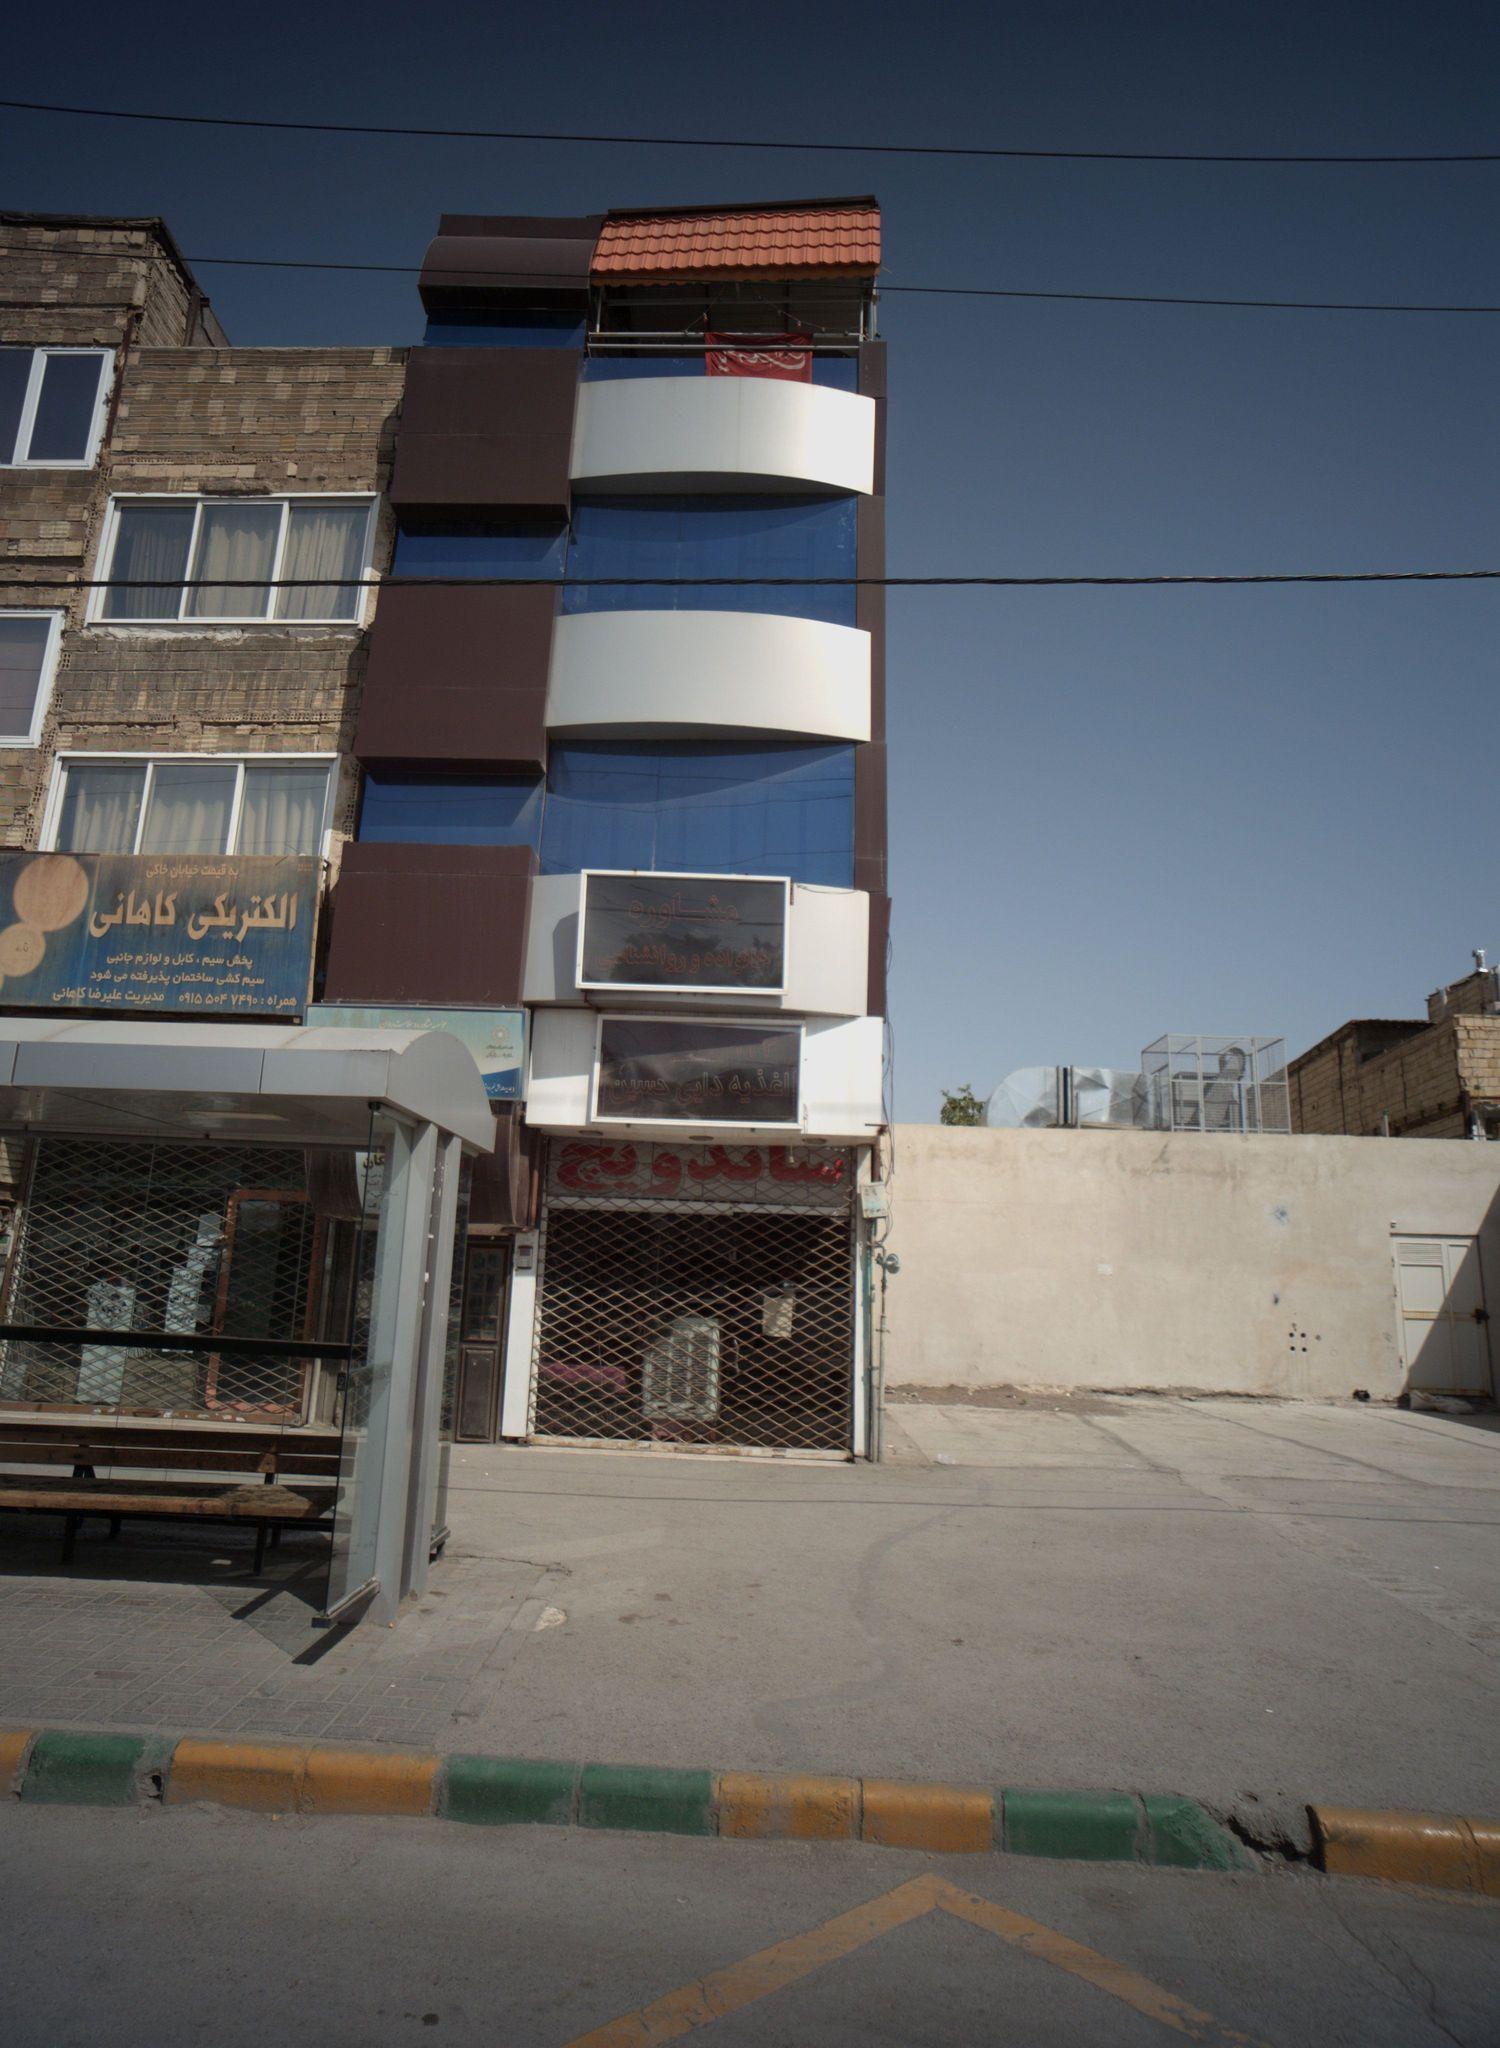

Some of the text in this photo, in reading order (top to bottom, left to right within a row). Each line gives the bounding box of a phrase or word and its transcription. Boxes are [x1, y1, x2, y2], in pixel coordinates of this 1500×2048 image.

[170, 864, 199, 878] خیابان
[200, 863, 226, 877] قیمت
[228, 866, 239, 878] به
[89, 889, 299, 943] الکتریکی کاهانی
[106, 953, 133, 966] جانبی
[135, 953, 162, 966] لوازم
[173, 953, 194, 967] کابل
[202, 956, 224, 967] سیم
[226, 955, 253, 969] پخش
[90, 969, 265, 987] سیم کشی ساختمان پذیرفته می شود
[53, 986, 165, 1005] مدیریت علیرضا کاهانی
[267, 994, 298, 1009] همراه
